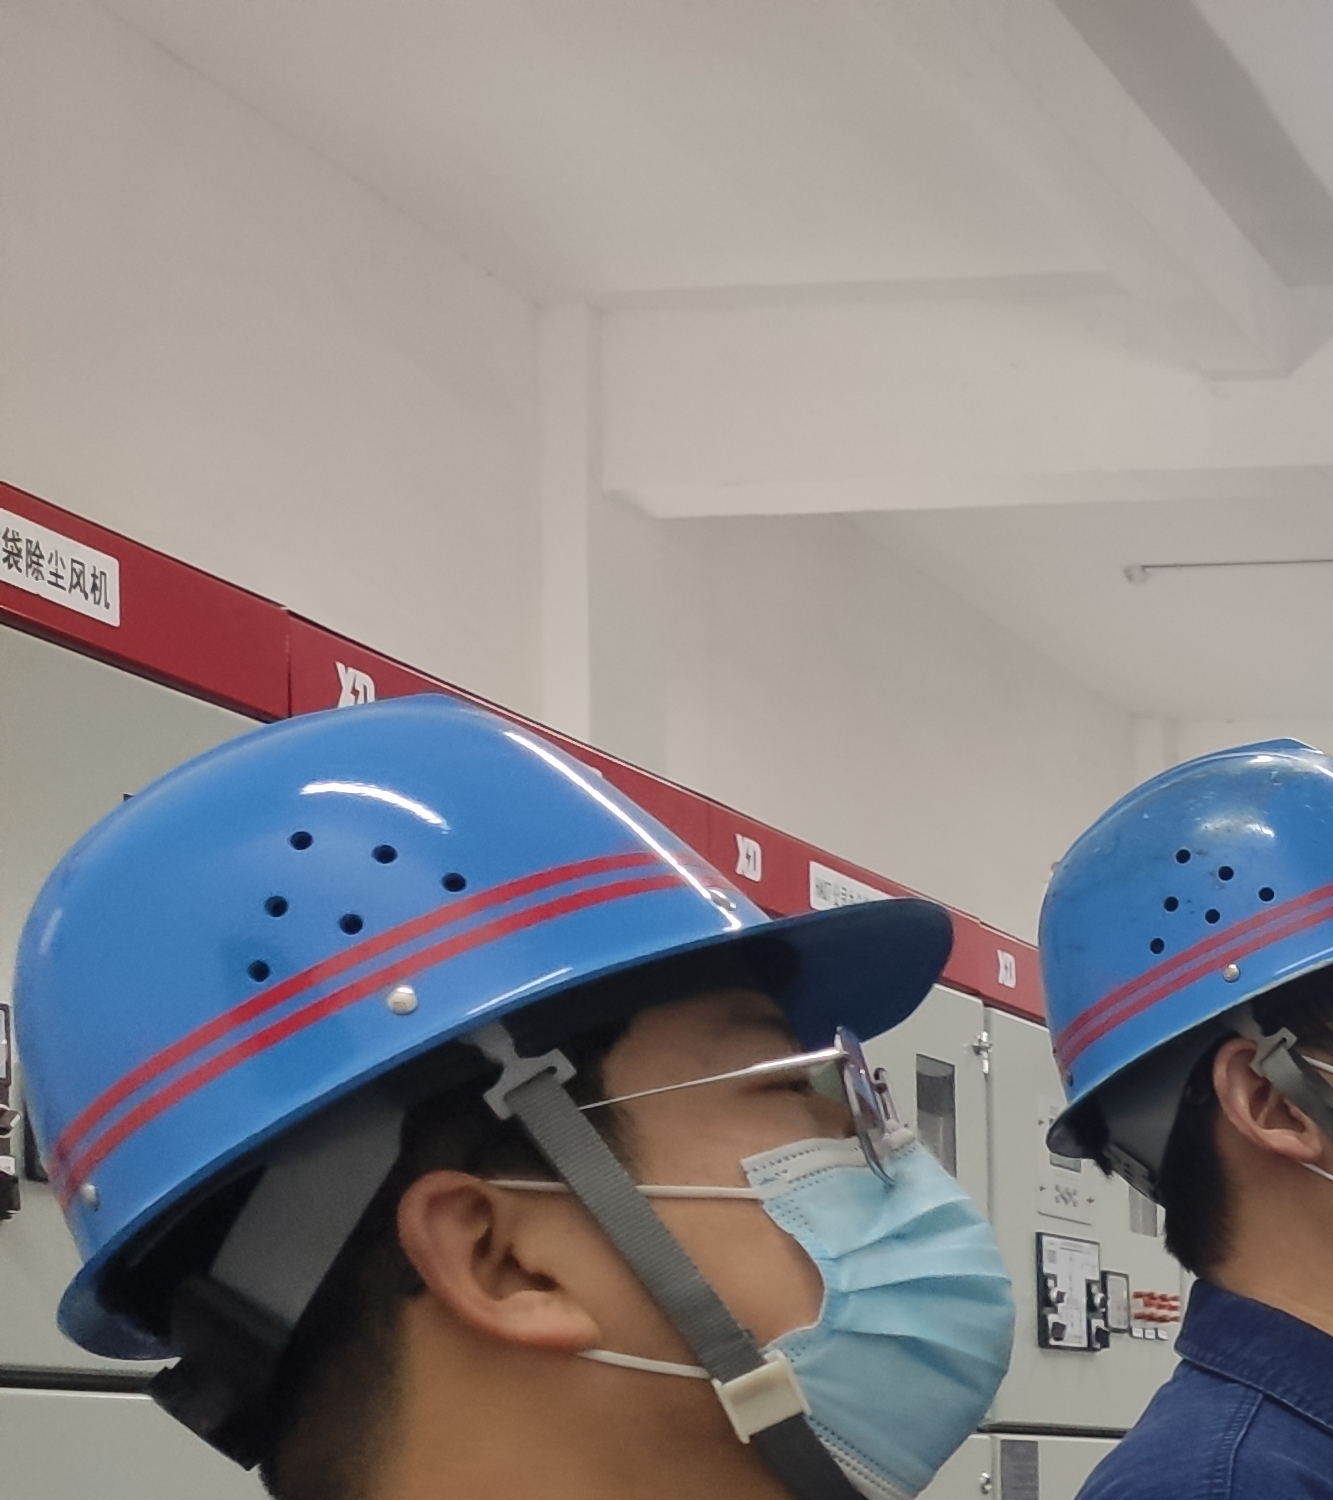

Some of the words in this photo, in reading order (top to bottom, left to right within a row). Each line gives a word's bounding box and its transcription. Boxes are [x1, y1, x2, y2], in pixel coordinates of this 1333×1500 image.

[2, 527, 110, 610] 袋除尘风机
